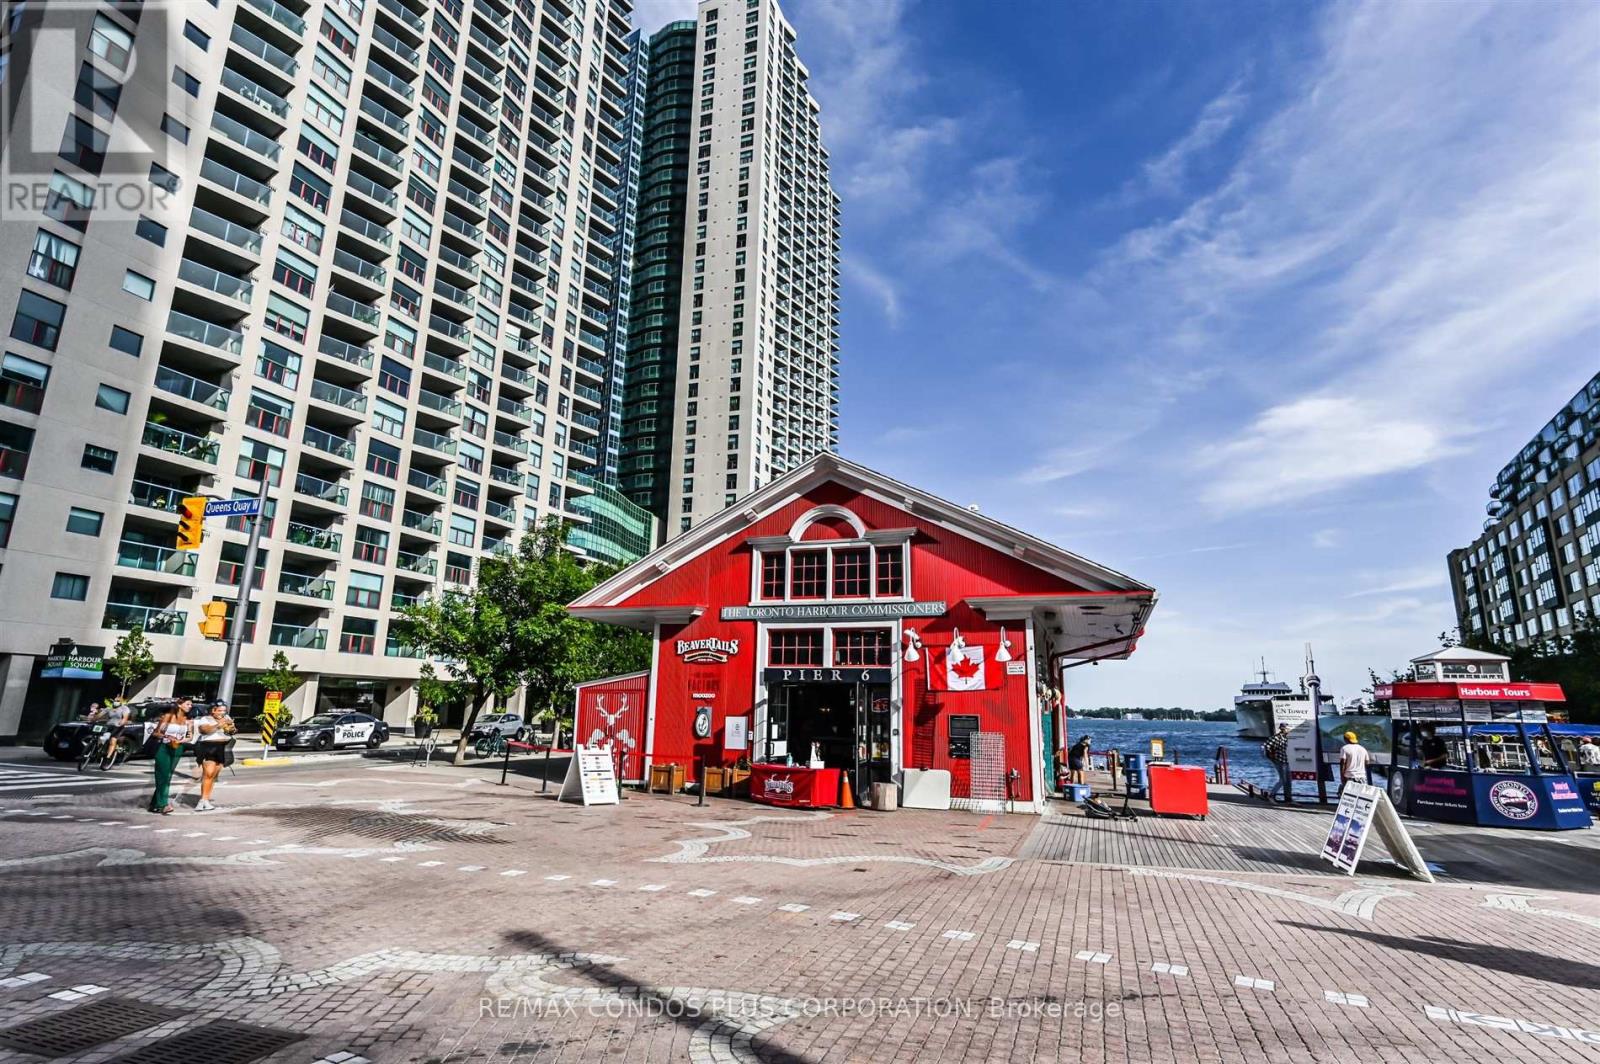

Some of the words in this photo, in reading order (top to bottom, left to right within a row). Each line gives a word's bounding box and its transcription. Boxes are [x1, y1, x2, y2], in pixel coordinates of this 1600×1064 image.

[206, 502, 231, 513] Queens
[233, 501, 251, 513] Quay
[252, 499, 260, 511] W
[721, 607, 741, 618] THE
[746, 606, 793, 617] TORONTO
[797, 605, 847, 617] HARBOUR
[852, 603, 946, 615] COMMISSIONERS
[68, 655, 102, 663] HARBOUR
[70, 661, 98, 669] SQUARE
[782, 669, 842, 681] PIER
[861, 669, 870, 681] 6
[1460, 687, 1500, 696] Harbour
[1502, 688, 1531, 697] Tours
[342, 731, 365, 739] POLICE
[1494, 781, 1529, 795] TORONTO
